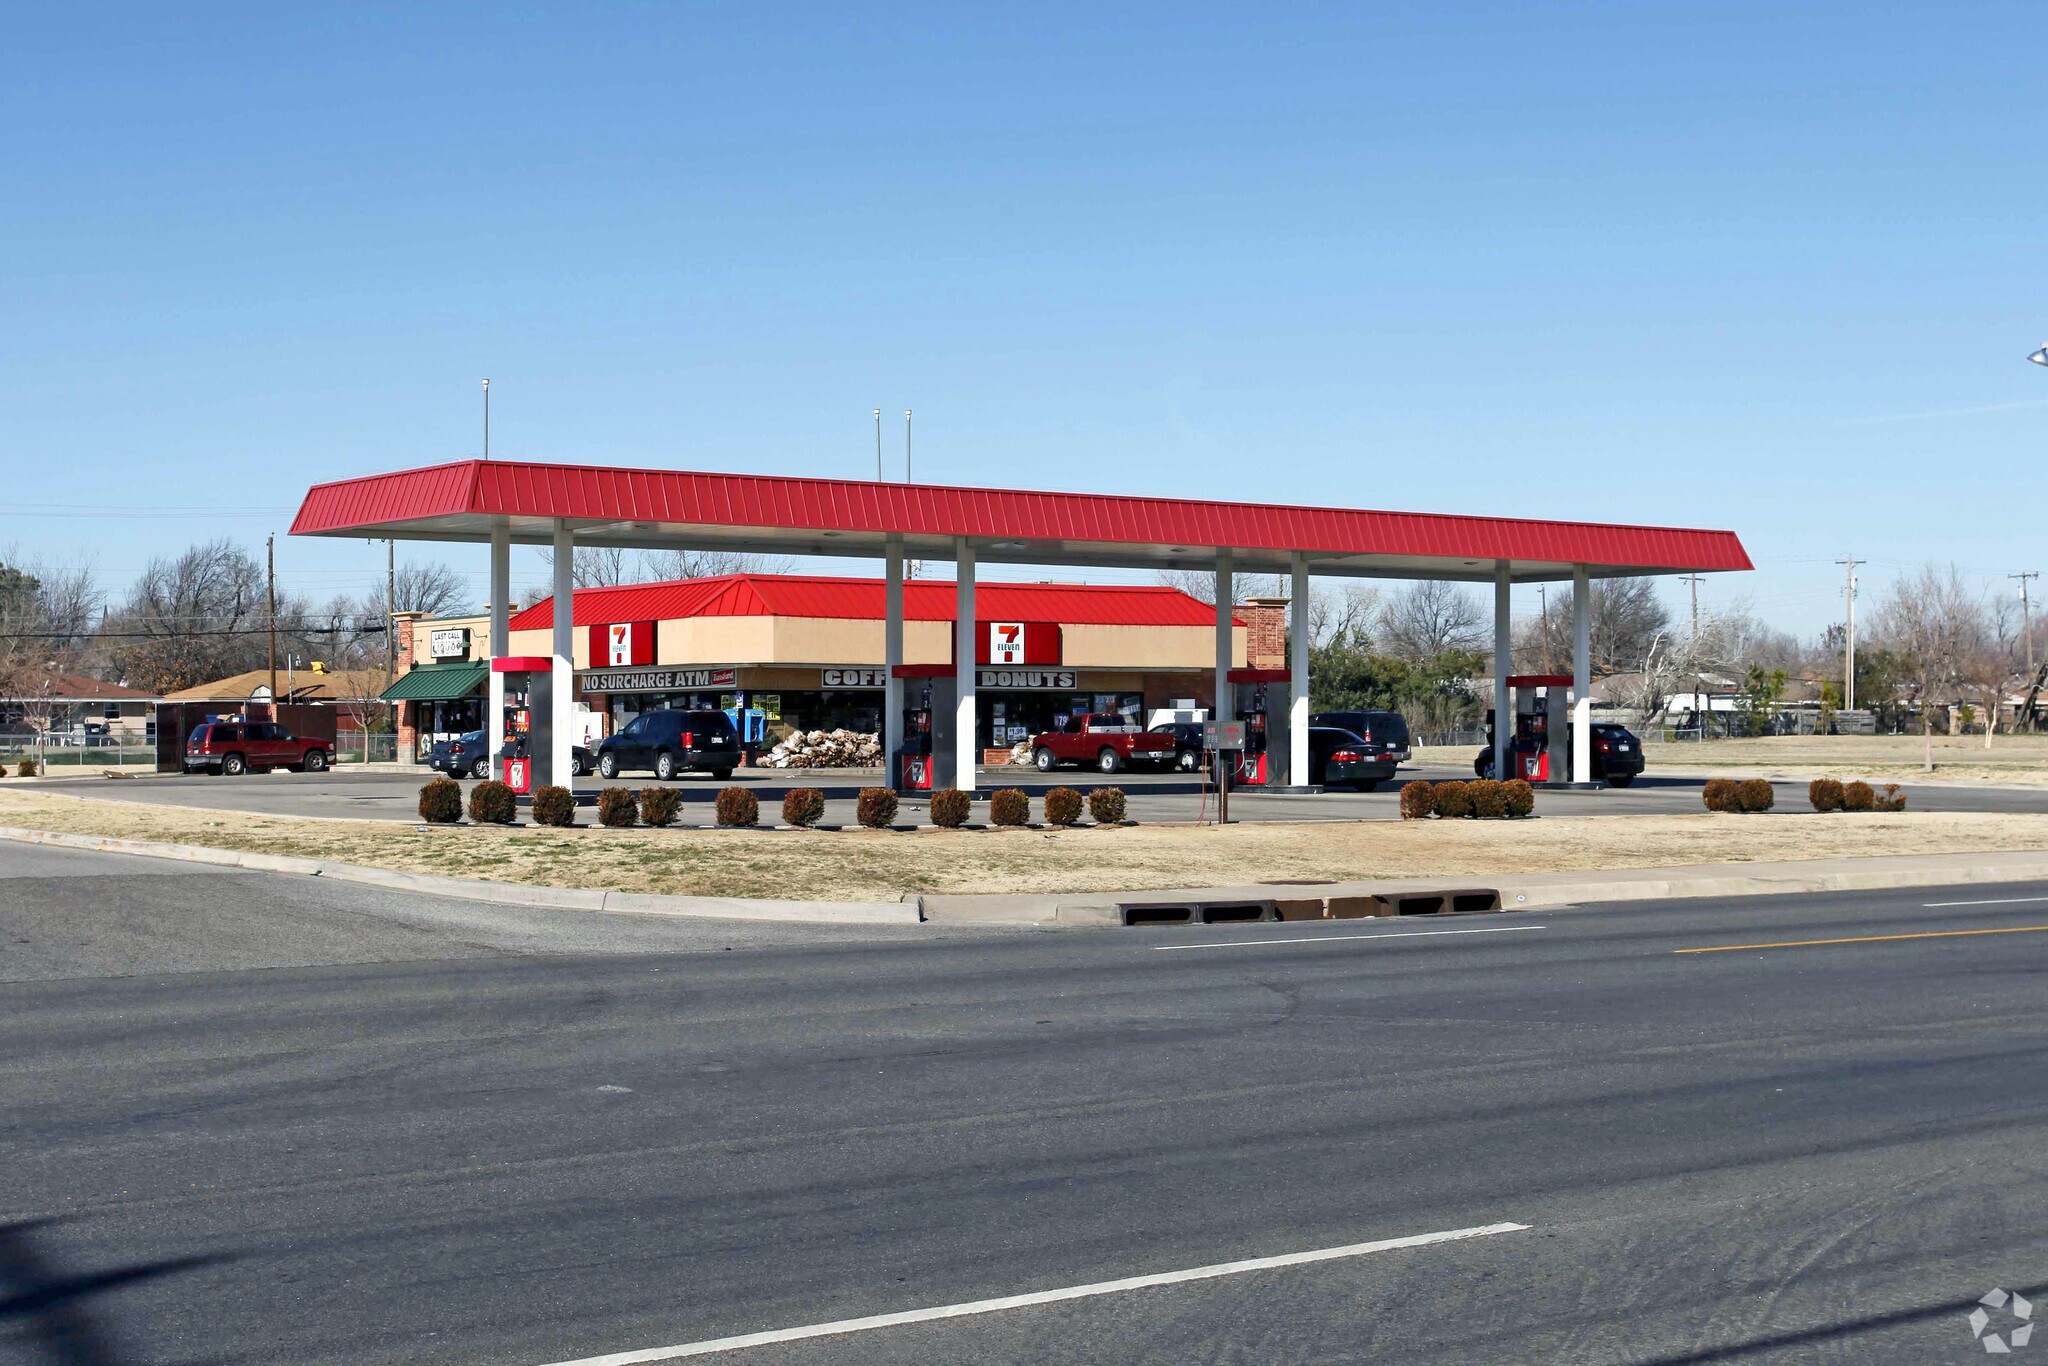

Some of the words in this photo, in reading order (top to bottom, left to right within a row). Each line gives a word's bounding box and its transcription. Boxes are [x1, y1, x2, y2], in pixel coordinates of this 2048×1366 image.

[434, 632, 447, 641] LAST
[583, 675, 599, 690] NO
[600, 672, 672, 689] SURCHARGE
[675, 670, 709, 687] ATM
[825, 670, 886, 686] COFF
[982, 671, 1073, 687] DONUTS
